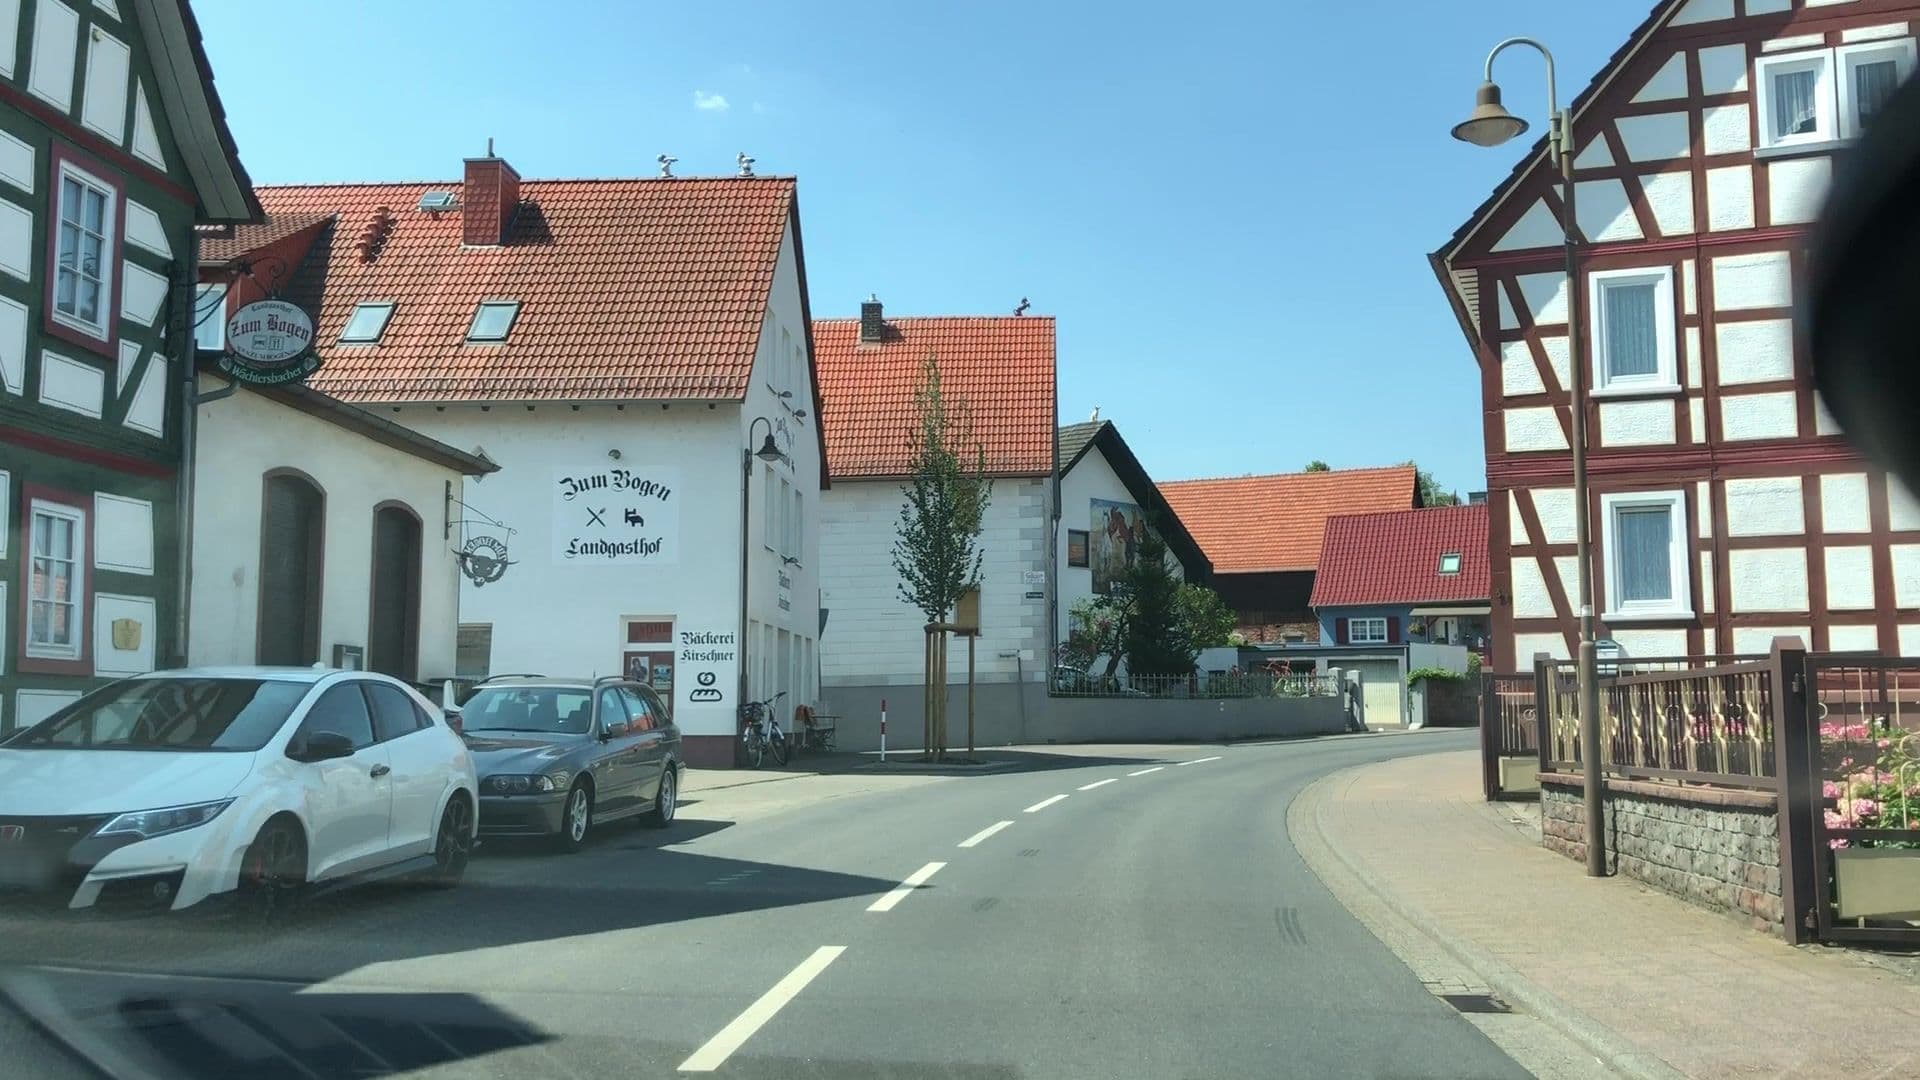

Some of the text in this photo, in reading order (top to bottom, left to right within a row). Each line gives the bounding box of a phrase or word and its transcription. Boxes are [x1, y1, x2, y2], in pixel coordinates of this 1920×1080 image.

[231, 313, 310, 342] Zum Bogen
[231, 365, 302, 384] Wächtersbacher
[559, 469, 671, 501] Zum Bogen
[564, 537, 663, 559] Landgasthof
[680, 631, 734, 645] Bäckerei
[680, 649, 735, 663] Kirschner
